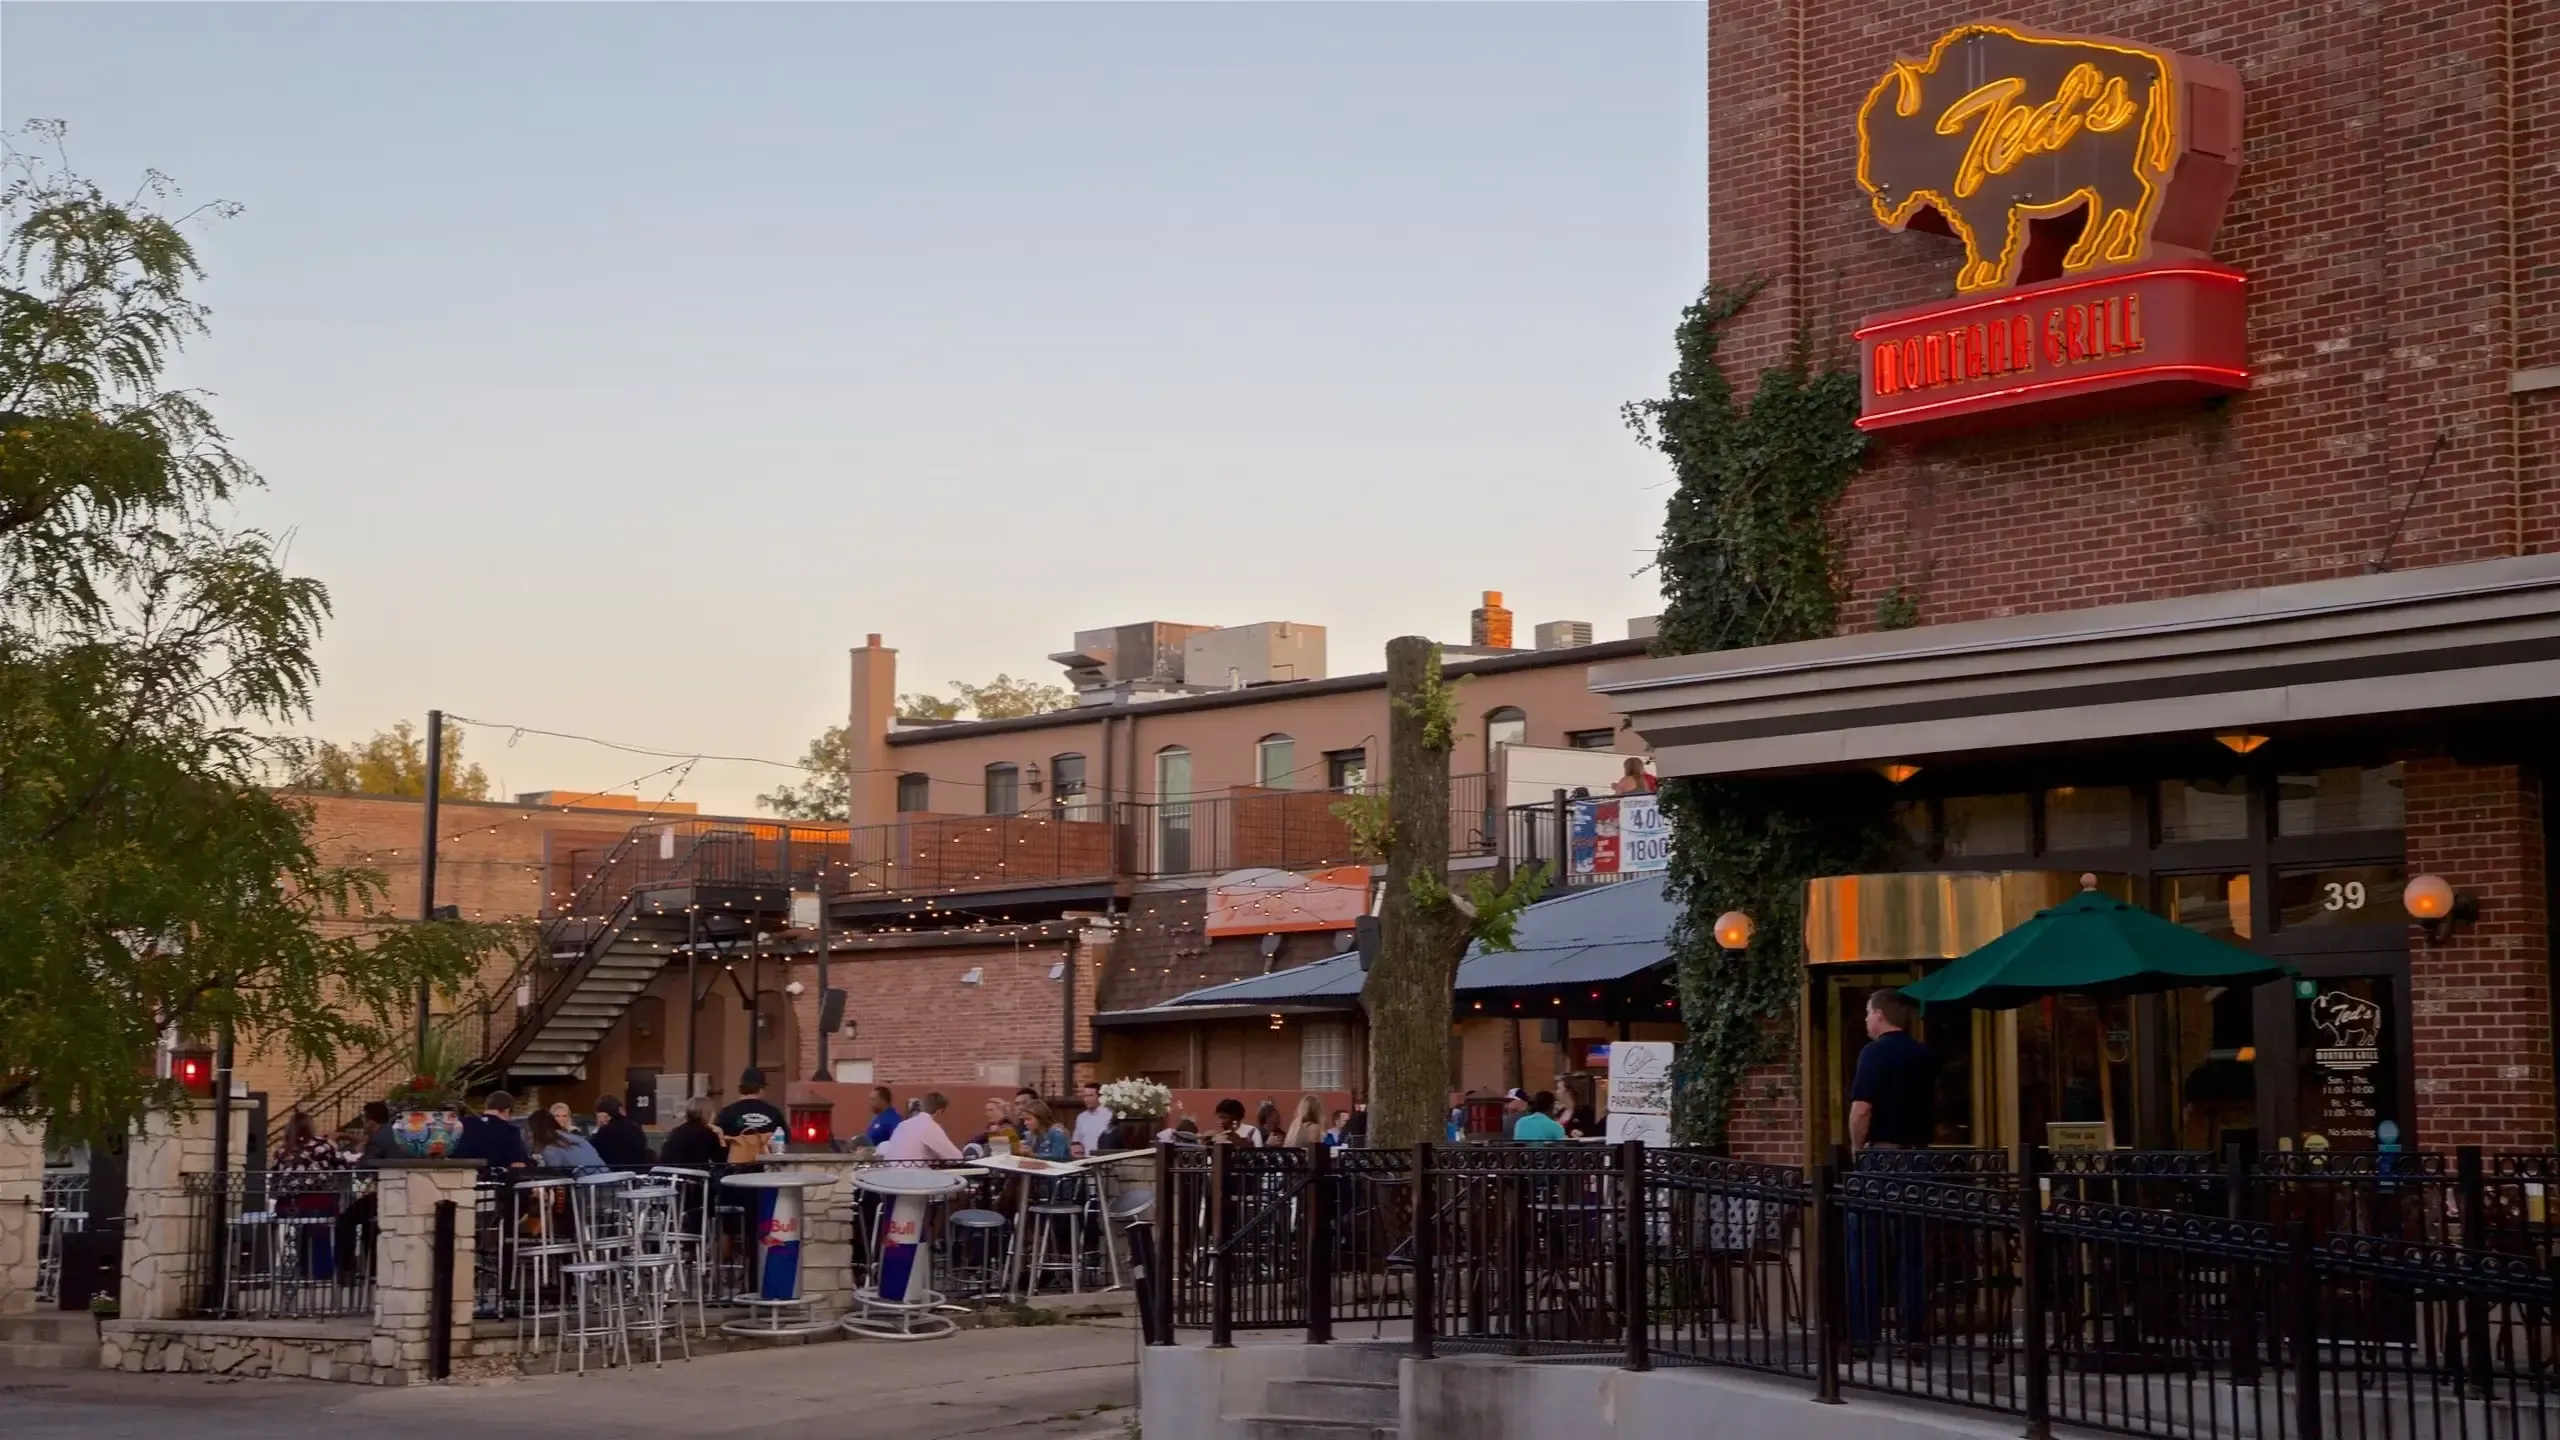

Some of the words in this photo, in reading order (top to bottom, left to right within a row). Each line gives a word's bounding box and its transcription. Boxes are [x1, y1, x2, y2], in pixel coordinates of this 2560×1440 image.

[1936, 62, 2138, 198] Ted's
[1874, 313, 2035, 397] MONTANA
[2044, 293, 2146, 368] GRILL
[2323, 881, 2366, 911] 39
[2329, 1004, 2373, 1026] Ted's
[2328, 1128, 2340, 1136] No
[2341, 1128, 2376, 1138] Smoking
[771, 1217, 798, 1233] Bull
[889, 1220, 916, 1236] Bull
